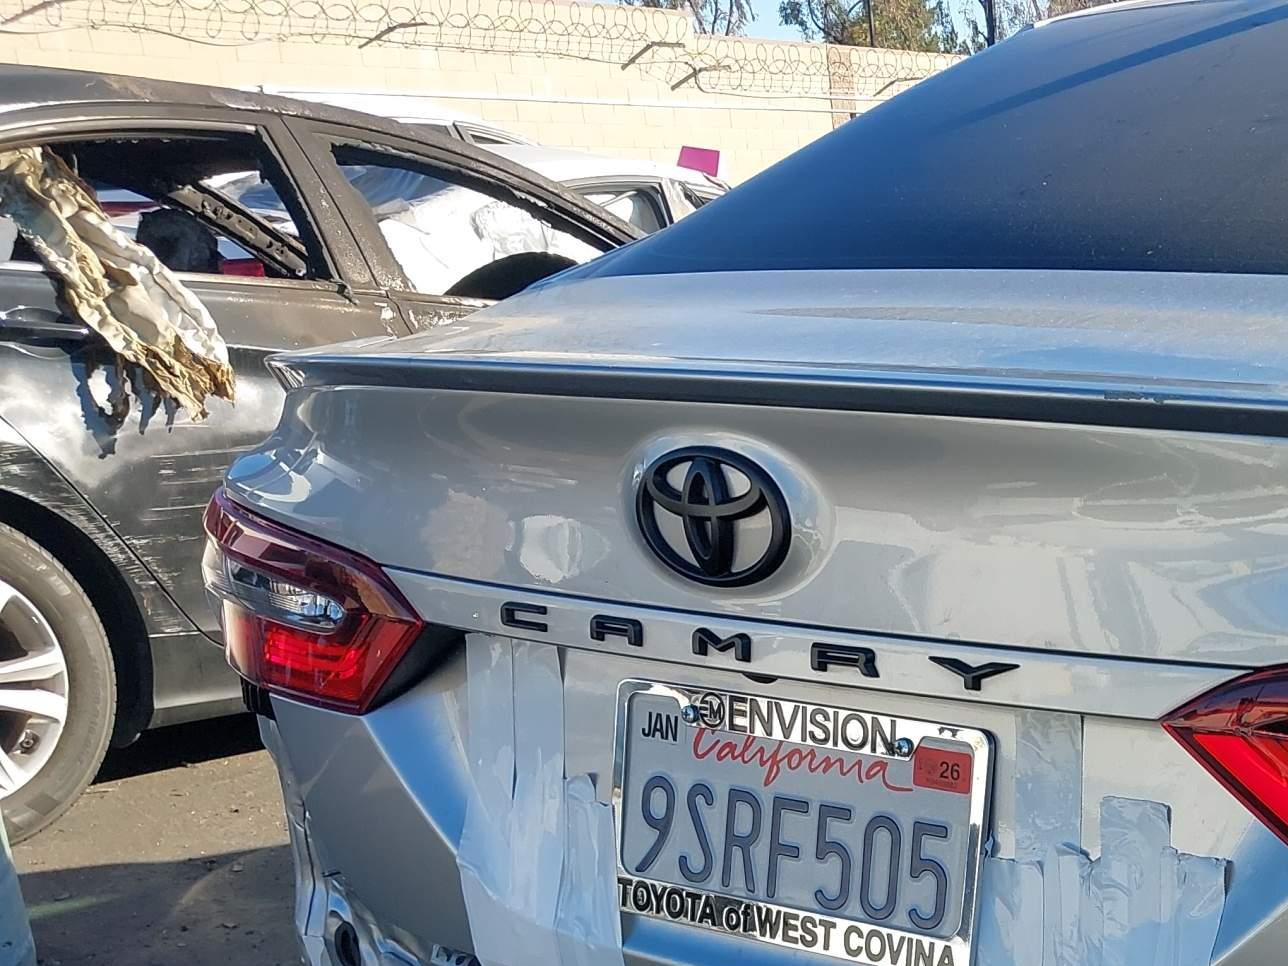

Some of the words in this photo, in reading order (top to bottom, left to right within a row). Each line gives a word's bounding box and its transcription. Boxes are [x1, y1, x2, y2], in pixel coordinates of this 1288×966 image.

[500, 601, 1020, 691] CAMRY
[641, 710, 679, 742] JAN
[728, 696, 898, 757] ENVISION
[692, 727, 914, 793] California
[939, 761, 960, 781] 26
[635, 775, 949, 930] 9SRF505
[618, 877, 717, 928] TOYOTA
[723, 902, 751, 935] of
[754, 905, 837, 951] WEST
